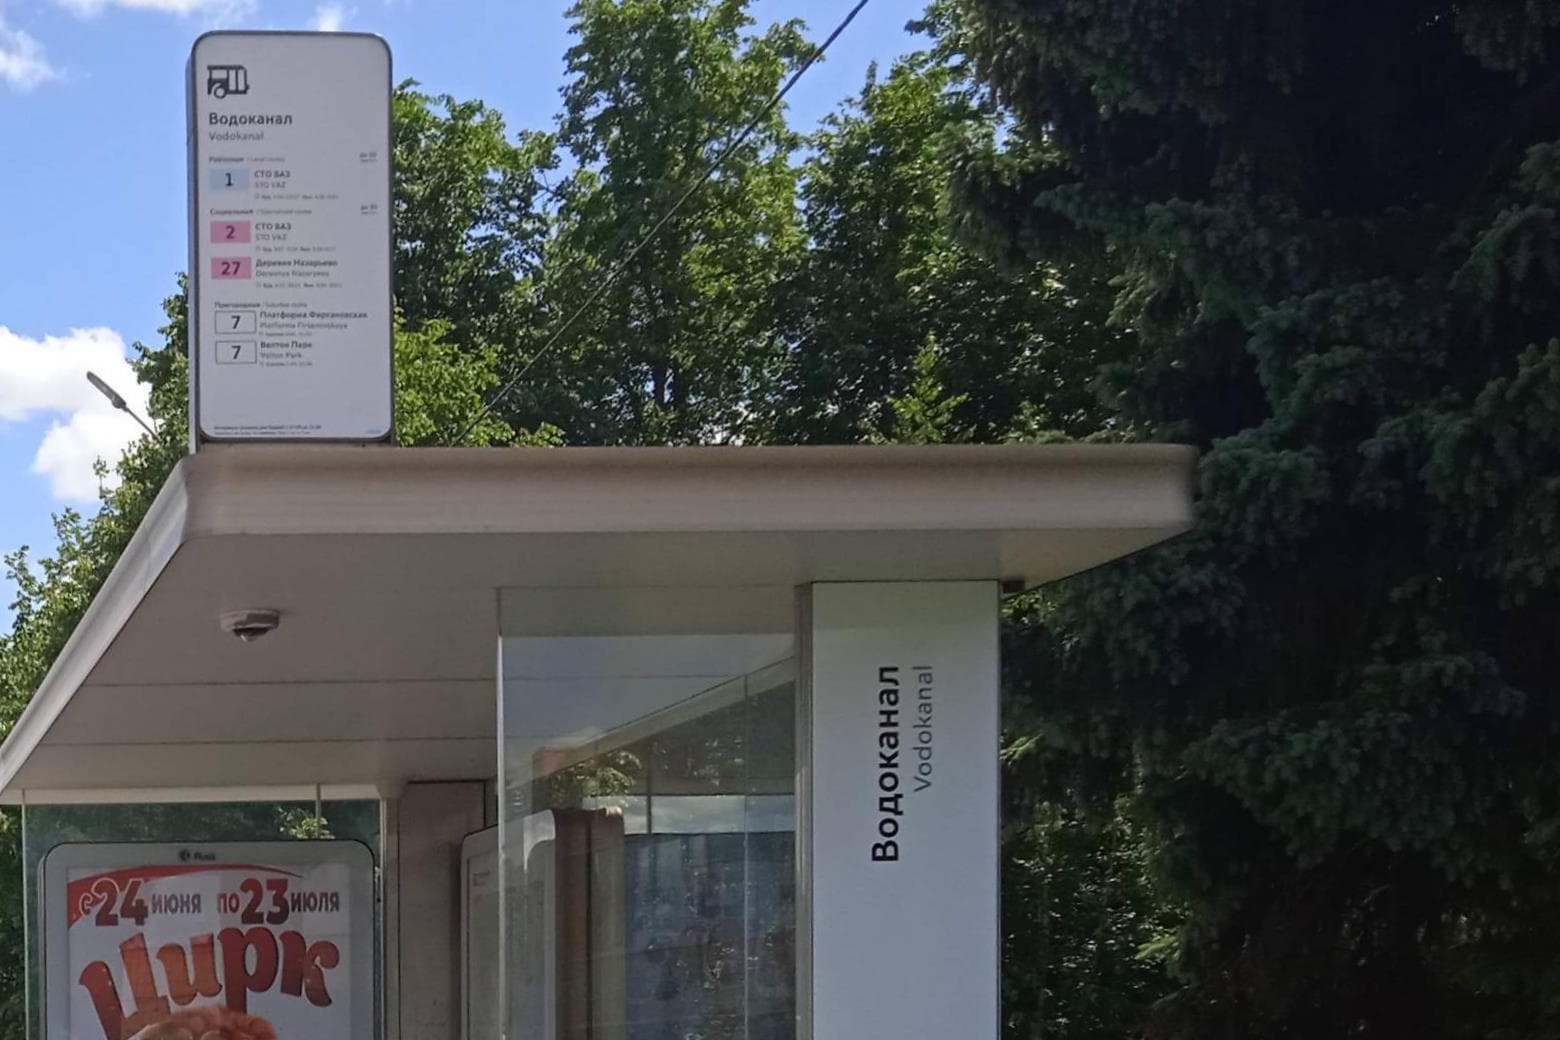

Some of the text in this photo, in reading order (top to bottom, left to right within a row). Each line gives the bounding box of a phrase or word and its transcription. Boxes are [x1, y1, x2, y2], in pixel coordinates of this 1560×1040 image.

[208, 113, 293, 126] Водоканал
[208, 132, 264, 141] Vodokanal
[225, 172, 233, 186] 1
[254, 170, 290, 178] СТО ВАЗ
[225, 225, 235, 239] 2
[255, 223, 291, 231] СТО ВАЗ
[221, 261, 241, 276] 27
[231, 315, 241, 329] 7
[231, 345, 241, 360] 7
[911, 666, 933, 792] Vodokanal
[871, 666, 904, 862] Водоканал
[90, 877, 149, 927] 24
[151, 893, 202, 914] ИЮНЯ
[240, 878, 290, 925] 23
[290, 892, 340, 913] ИЮЛЯ
